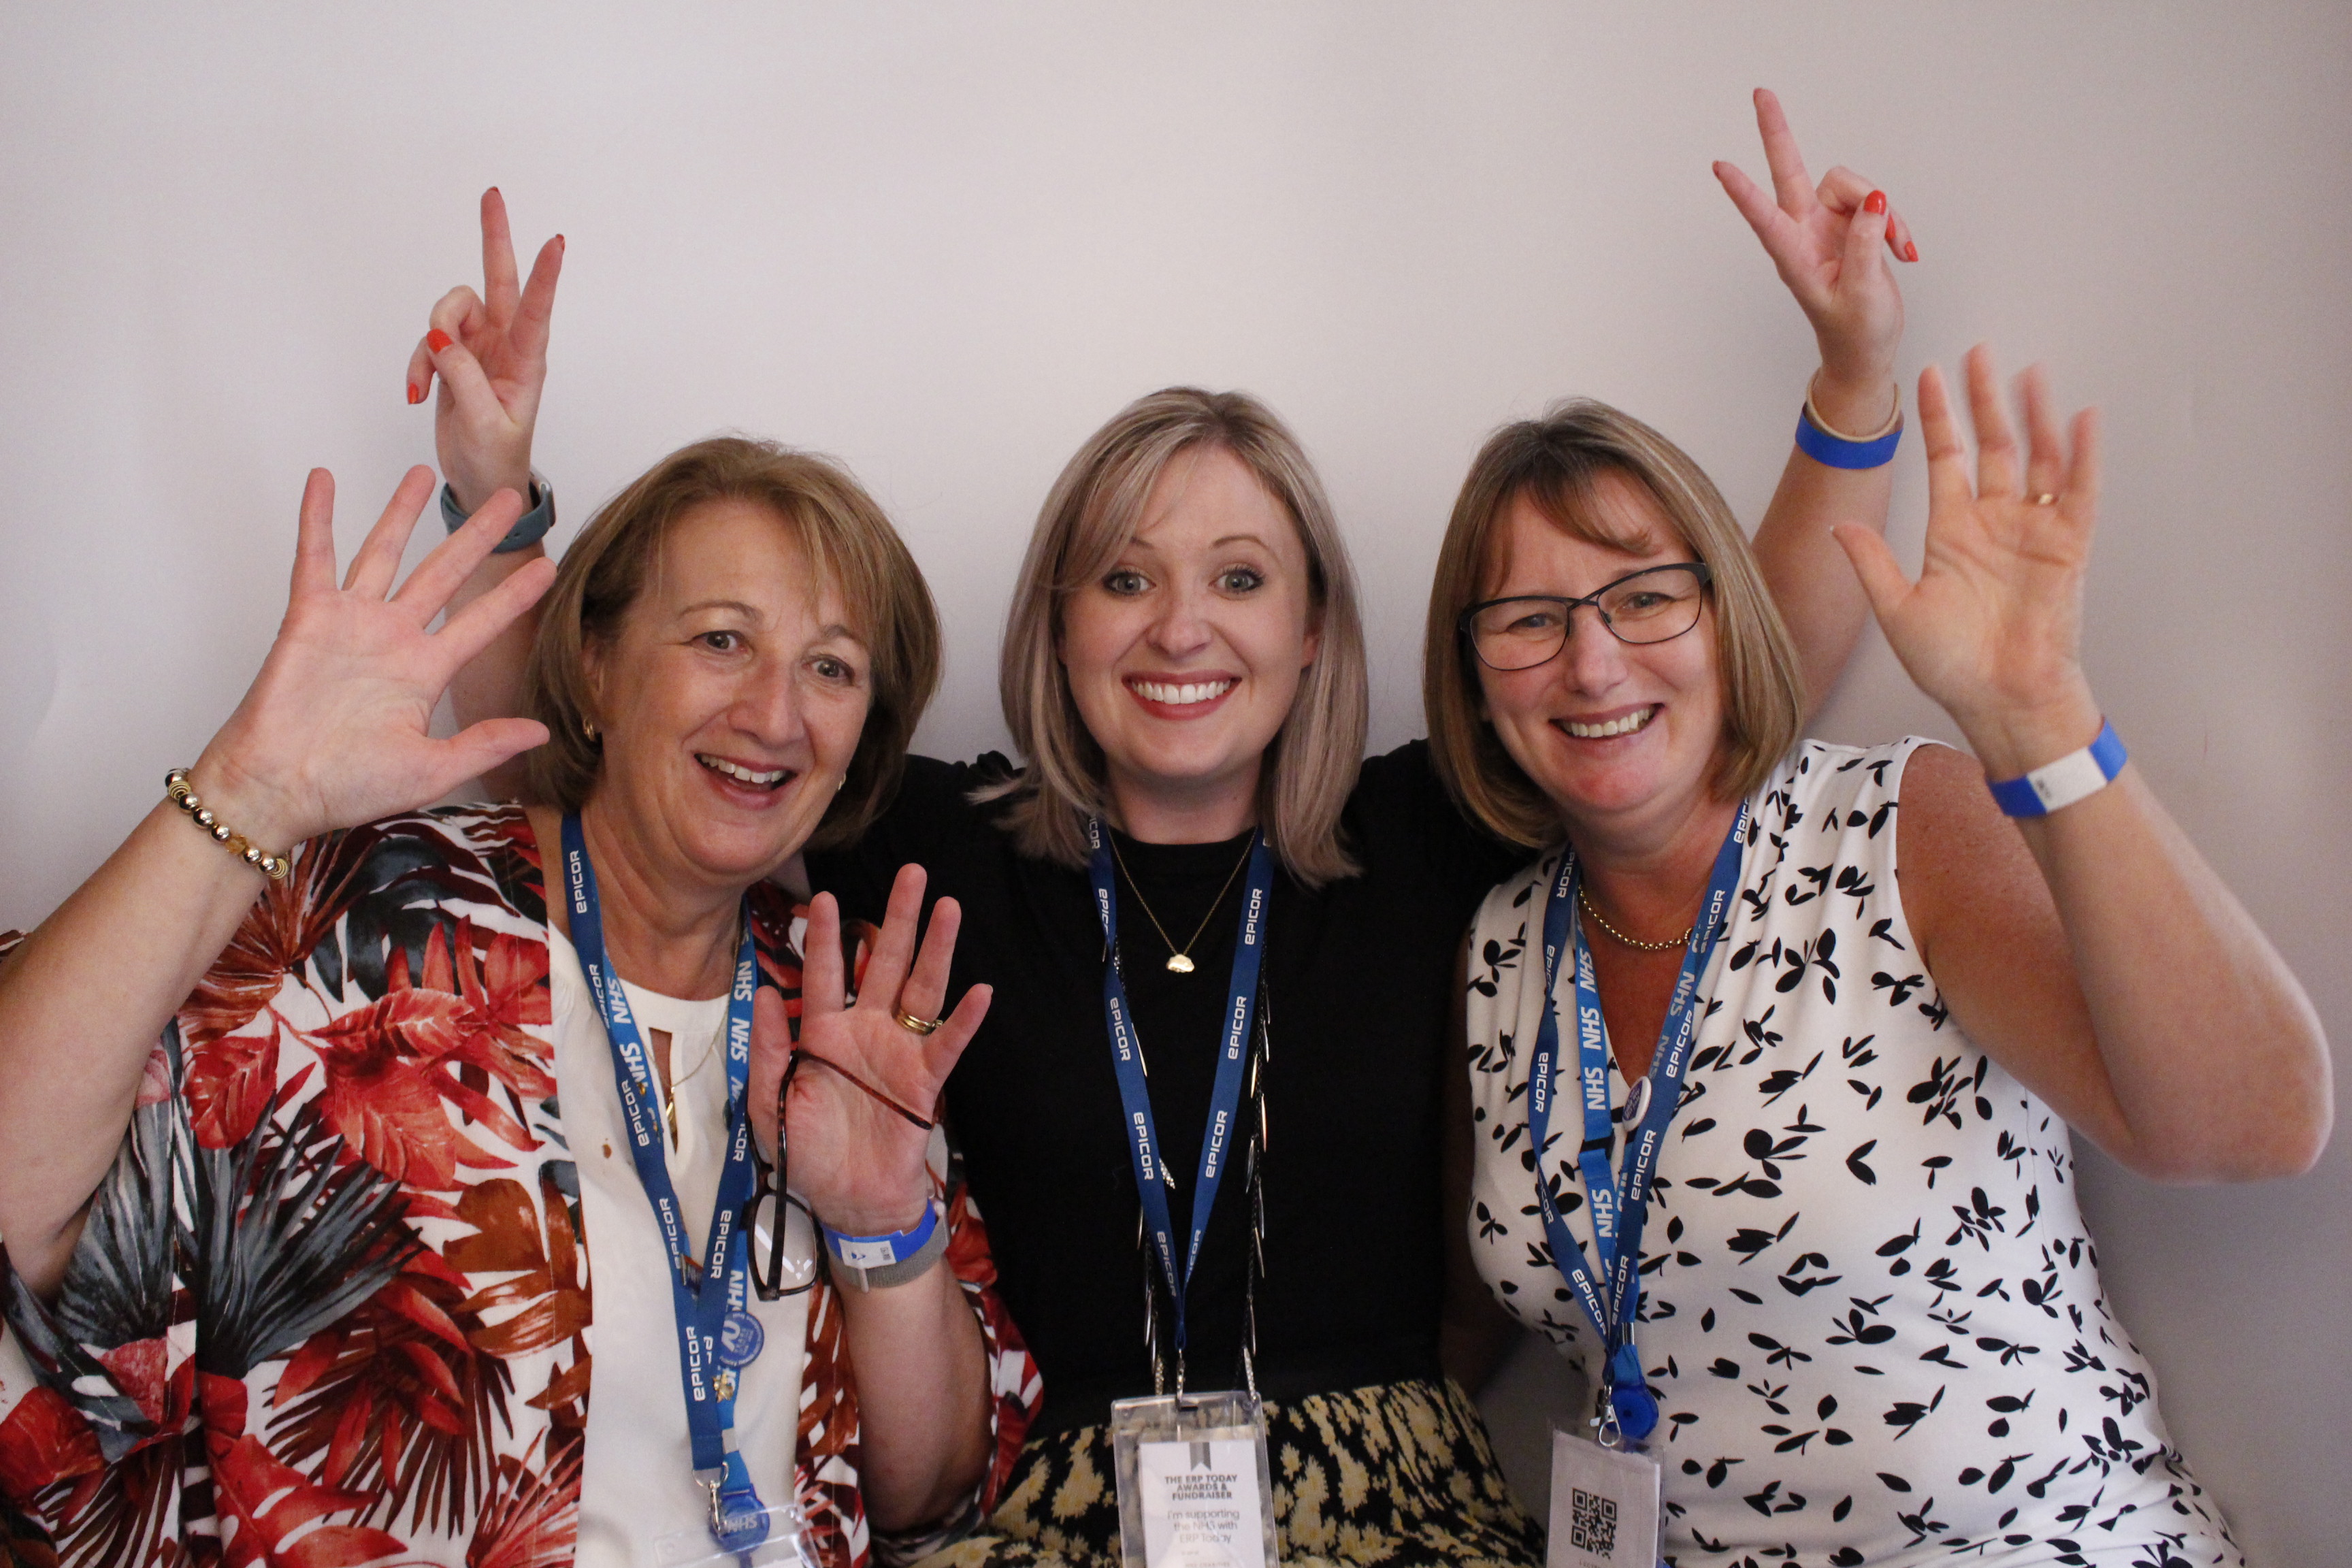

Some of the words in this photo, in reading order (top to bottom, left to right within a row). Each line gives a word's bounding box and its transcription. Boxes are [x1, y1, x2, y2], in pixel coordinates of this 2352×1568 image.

[734, 960, 752, 1002] NHS
[1579, 947, 1597, 993] NHS
[606, 977, 632, 1024] NHS
[1670, 972, 1695, 1017] NHS
[730, 1017, 750, 1064] NHS
[1581, 1007, 1602, 1051] NHS
[1584, 1067, 1606, 1110] NHS
[1592, 1189, 1613, 1237] NHS
[726, 1270, 743, 1311] NH
[1164, 1475, 1182, 1484] THE
[1186, 1475, 1203, 1484] ERP
[1205, 1473, 1237, 1483] TODAY
[1172, 1491, 1232, 1501] FUNDRAISER
[1177, 1483, 1218, 1491] AWARDS
[1186, 1508, 1240, 1521] supporting
[1218, 1520, 1238, 1530] with
